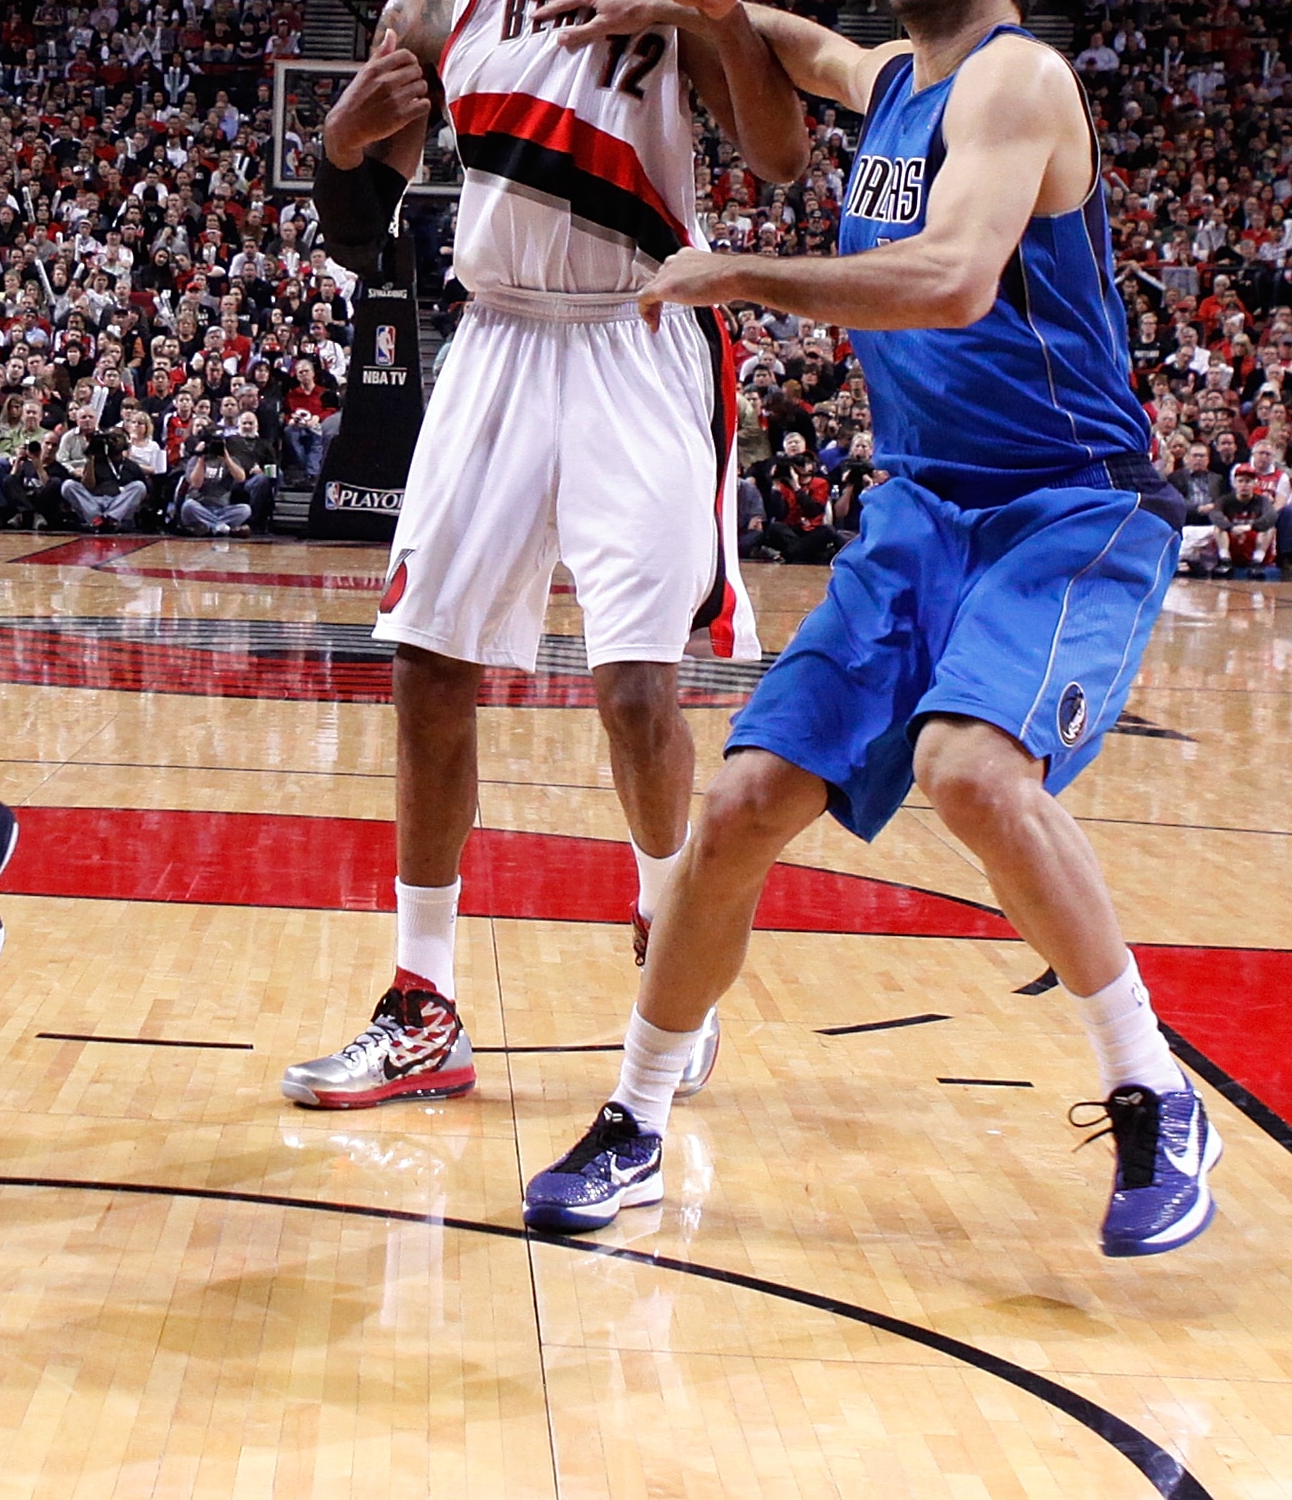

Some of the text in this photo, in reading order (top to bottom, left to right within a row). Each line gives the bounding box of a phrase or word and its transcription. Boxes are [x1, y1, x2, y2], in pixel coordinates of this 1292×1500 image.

[597, 34, 665, 100] 12
[363, 370, 407, 386] NBA TV
